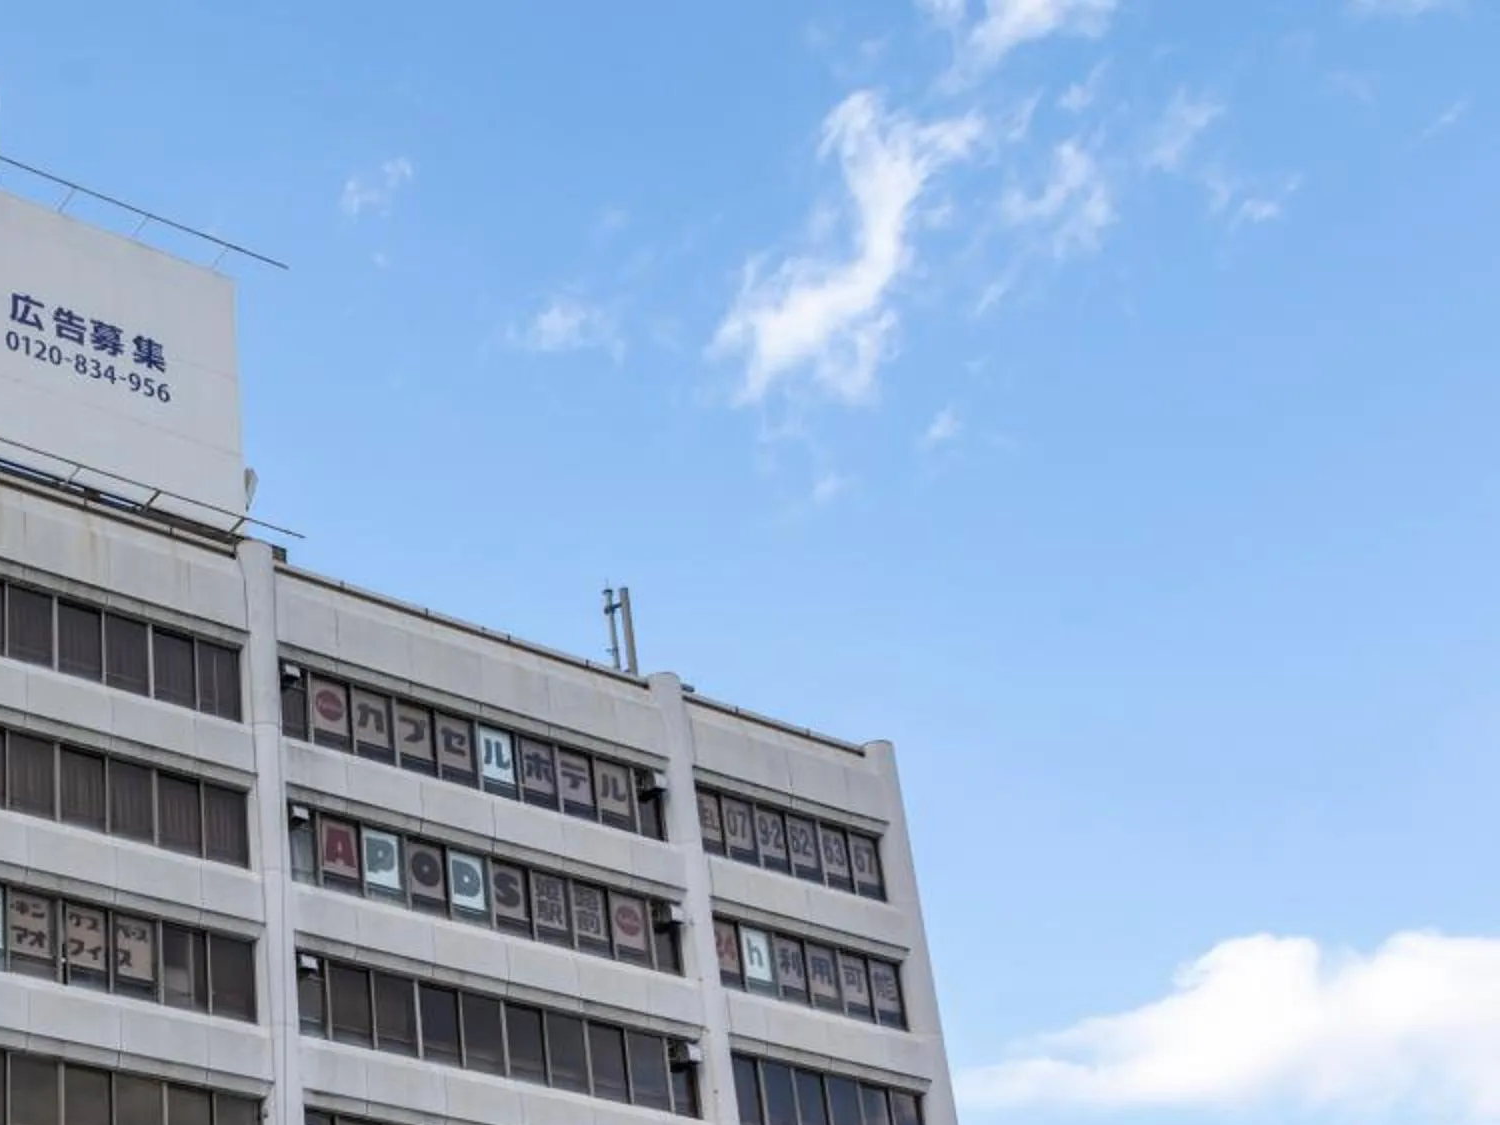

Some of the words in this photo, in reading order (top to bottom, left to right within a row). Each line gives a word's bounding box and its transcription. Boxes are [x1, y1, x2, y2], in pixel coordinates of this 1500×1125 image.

[5, 329, 173, 405] 0120-834-956
[7, 291, 170, 374] 広告募集
